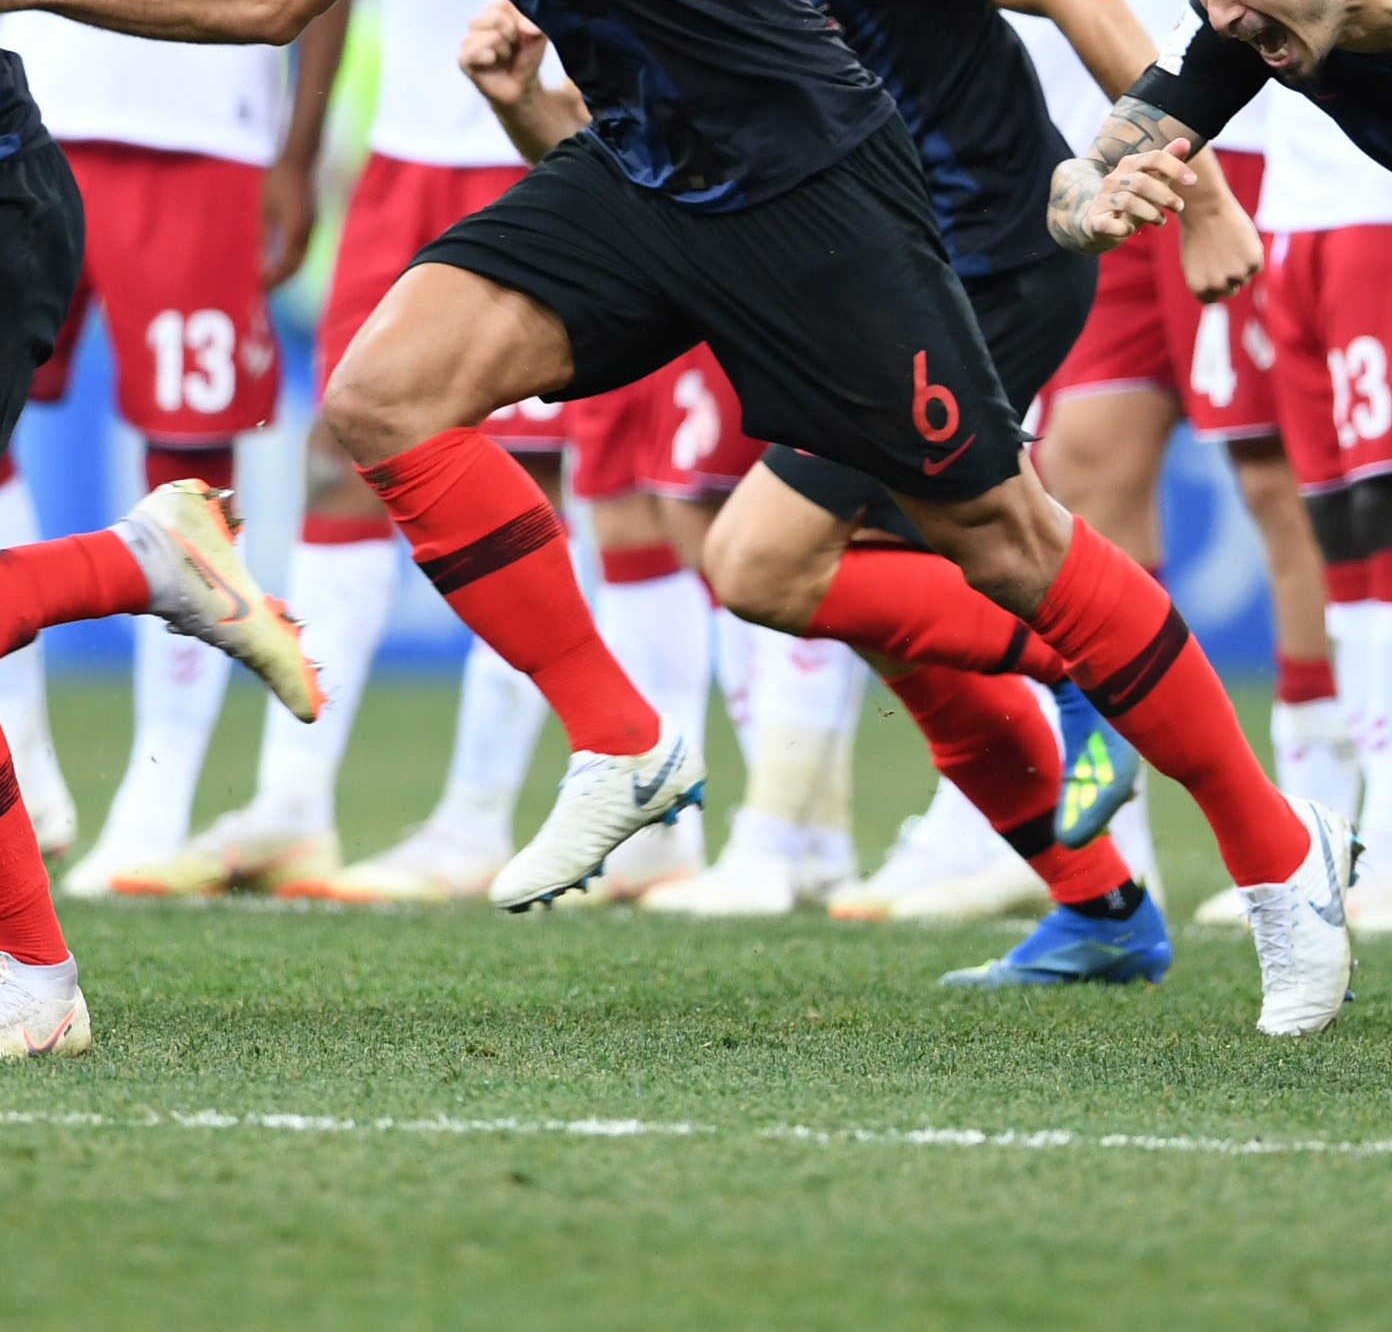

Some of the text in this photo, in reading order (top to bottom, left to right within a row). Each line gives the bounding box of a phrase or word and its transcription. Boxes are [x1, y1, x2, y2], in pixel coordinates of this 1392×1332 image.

[146, 307, 236, 415] 13
[911, 349, 960, 443] 6
[1189, 301, 1238, 408] 4
